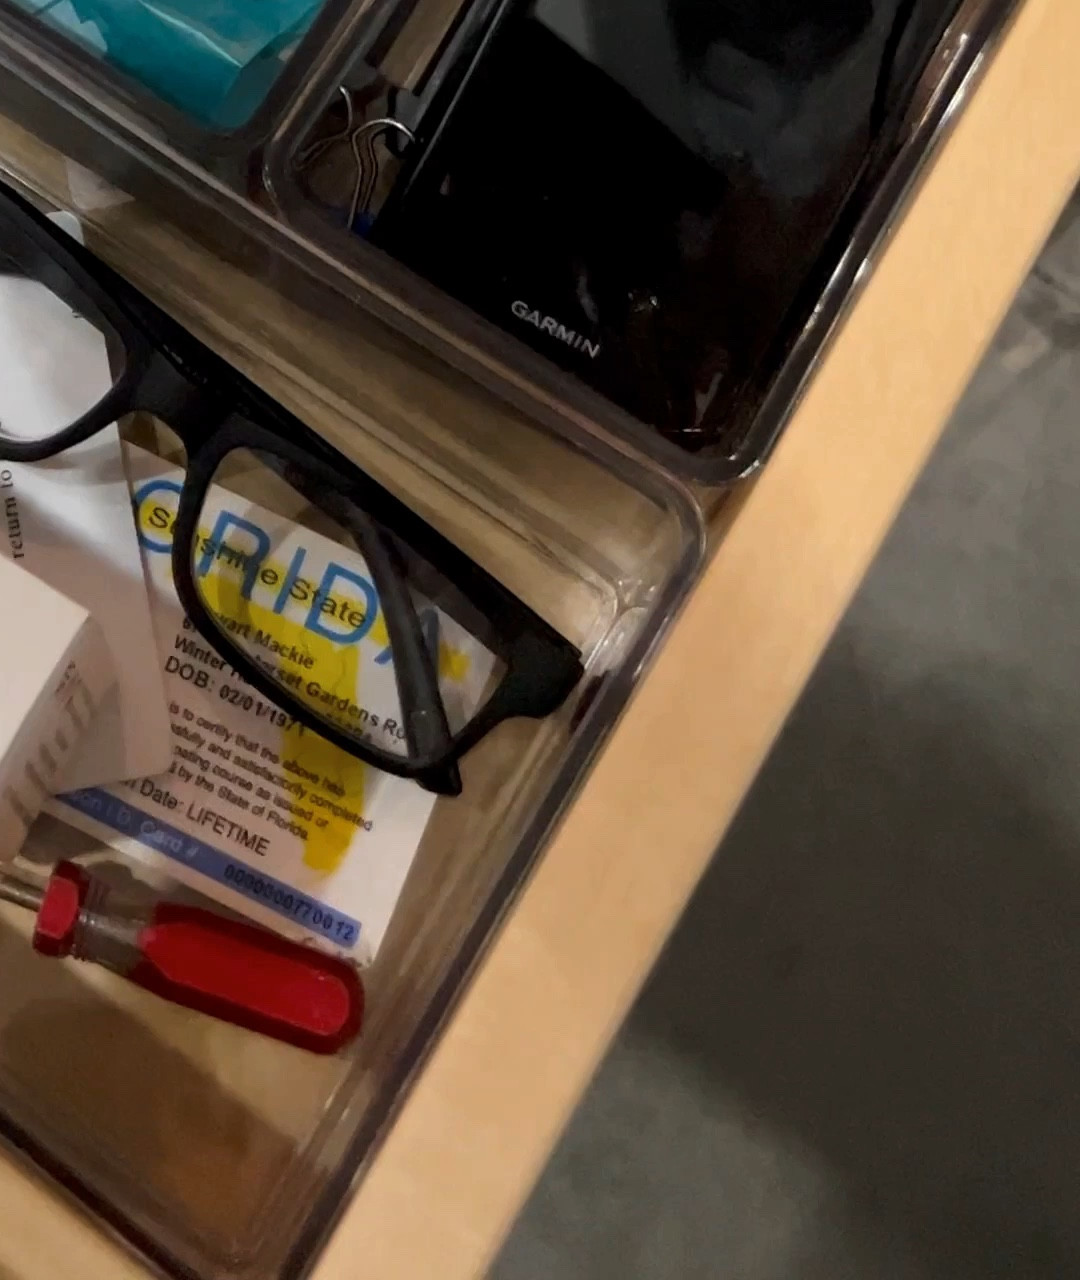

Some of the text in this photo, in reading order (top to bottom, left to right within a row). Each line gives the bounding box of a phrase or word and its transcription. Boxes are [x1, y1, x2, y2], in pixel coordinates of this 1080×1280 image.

[510, 299, 601, 359] GARMIN
[0, 469, 14, 489] to
[174, 633, 228, 672] Winter
[252, 629, 315, 670] Mackie
[164, 654, 215, 694] DOB:
[305, 680, 380, 727] Gardens
[186, 802, 272, 857] LIFETIME
